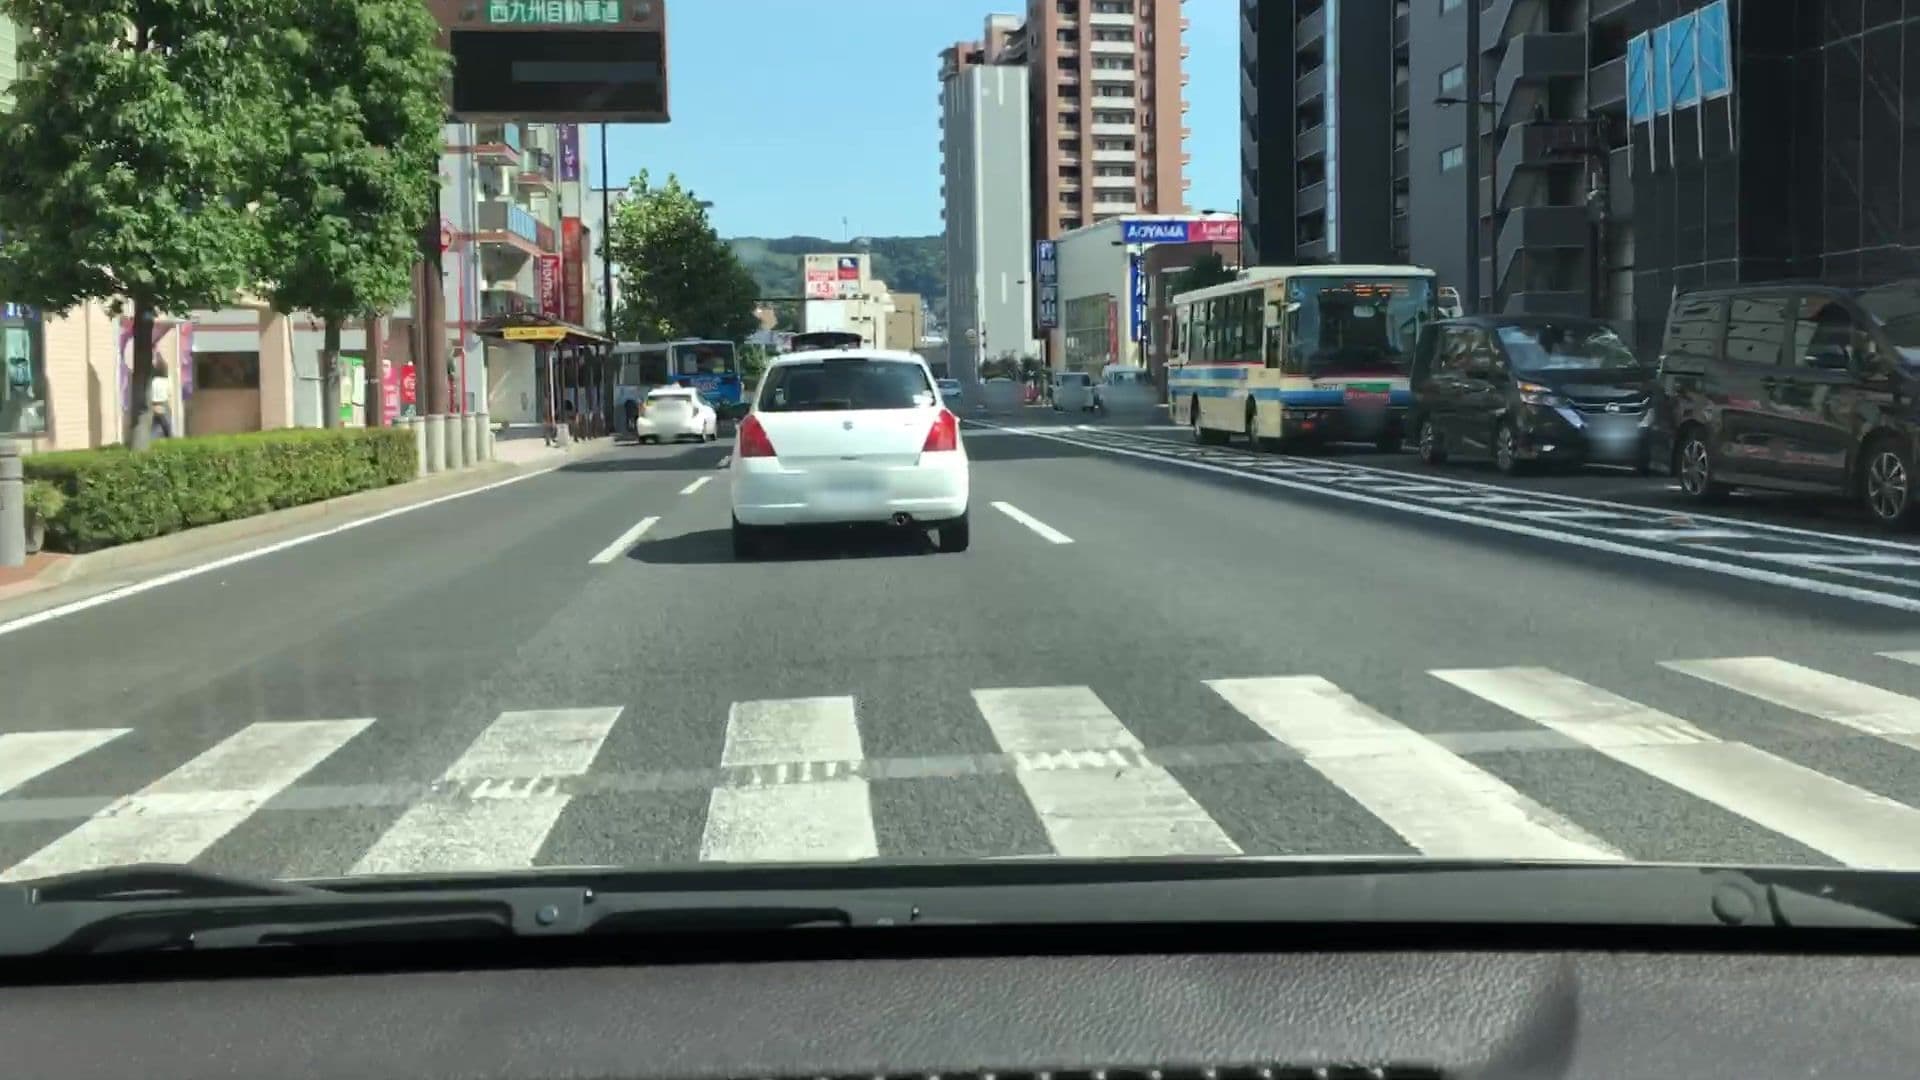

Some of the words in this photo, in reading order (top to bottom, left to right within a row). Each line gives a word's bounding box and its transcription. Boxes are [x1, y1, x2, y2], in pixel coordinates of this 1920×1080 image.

[490, 0, 619, 23] 西九州自動車道
[1127, 224, 1185, 238] AOYAMA
